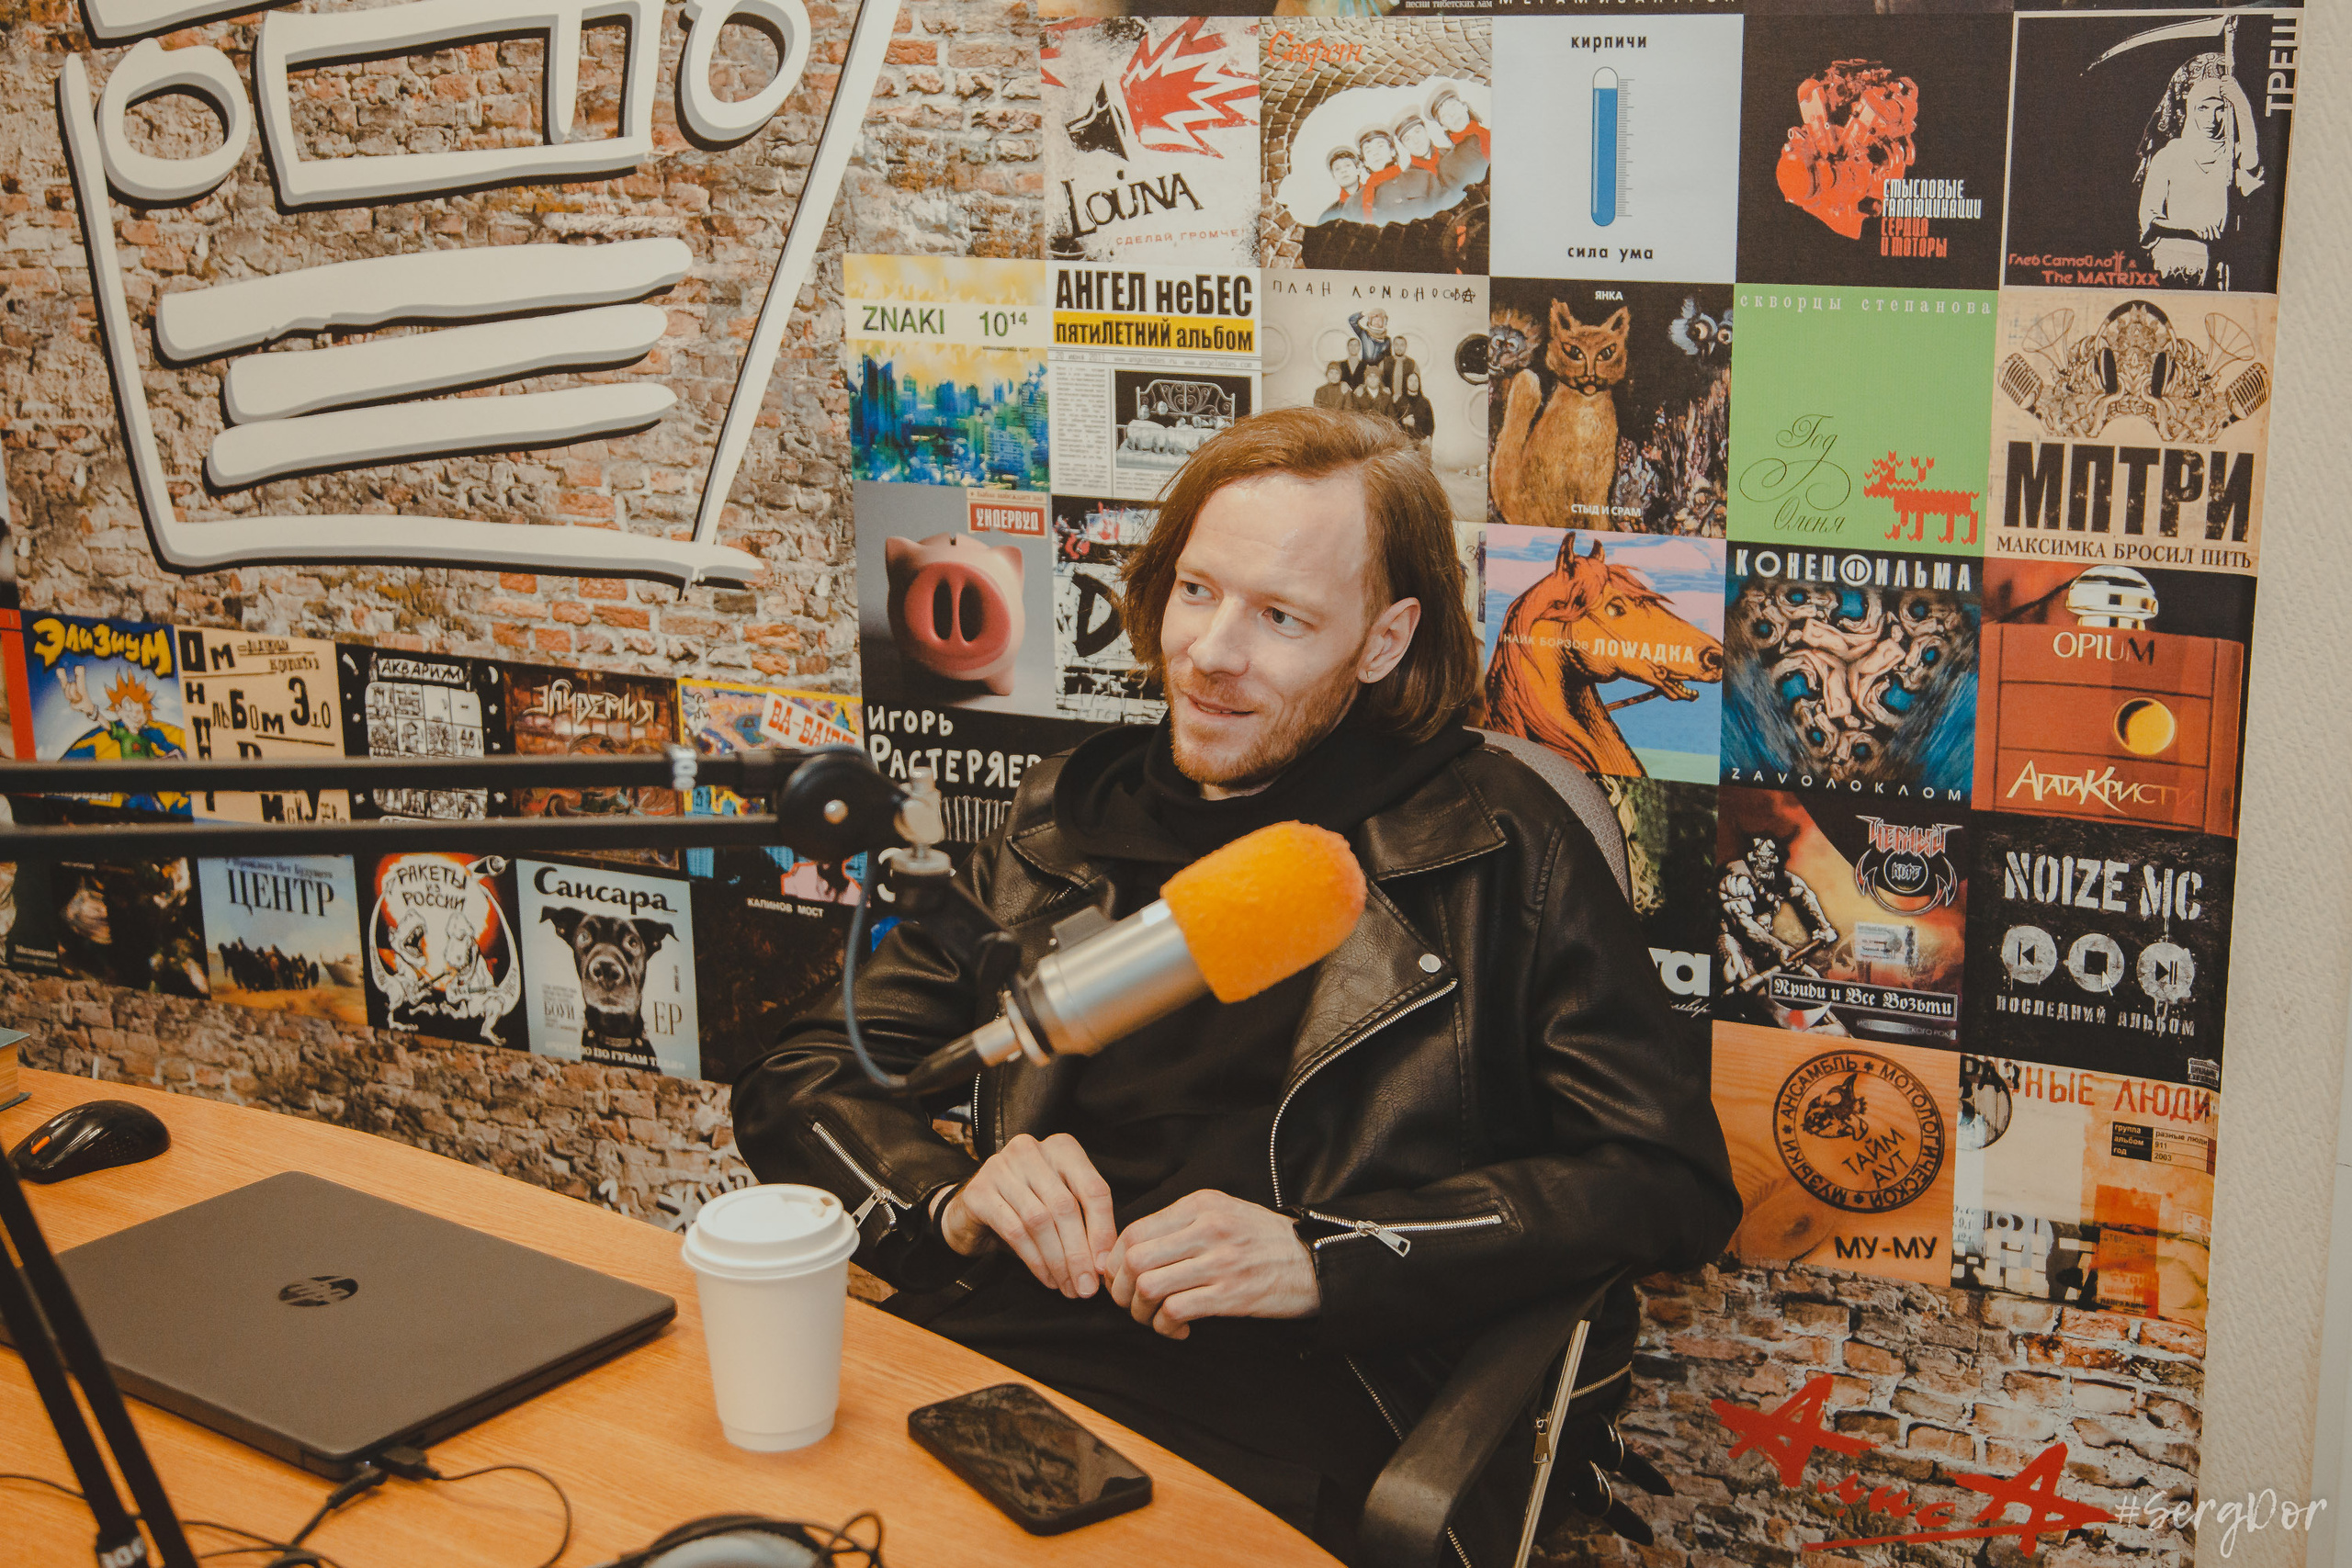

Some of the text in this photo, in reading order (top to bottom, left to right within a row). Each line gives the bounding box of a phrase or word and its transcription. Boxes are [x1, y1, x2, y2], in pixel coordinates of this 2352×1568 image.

[1268, 30, 1363, 73] Секрет
[1570, 36, 1647, 53] кирпичи
[1116, 232, 1172, 245] СДЕЛАЙ
[1567, 247, 1654, 264] сила ума
[1272, 279, 1331, 297] ПЛАН
[2041, 270, 2074, 285] The
[1055, 268, 1253, 317] АНГЕЛ неБЕС
[1594, 290, 1624, 302] ЯНКА
[1739, 293, 1991, 315] скворцы степанова
[862, 305, 945, 334] ZNAKI
[1176, 325, 1254, 352] альбом
[2004, 441, 2255, 543] МПТРИ
[1570, 503, 1643, 518] СТЫД И СРАМ
[1996, 535, 2252, 569] МАКСИМКА БРОСИЛ ПИТЬ
[2052, 630, 2155, 666] OPIUM
[866, 705, 954, 737] ИГОРЬ
[395, 864, 468, 890] РАКЕТЫ
[2004, 851, 2202, 921] NOIZE MC
[227, 868, 335, 917] ЦЕНТР
[401, 891, 467, 912] РОССИИ
[534, 866, 679, 916] Сансара
[1996, 994, 2195, 1038] ПОСЛЕДНИЙ АЛЬБОМ
[2112, 1078, 2211, 1124] ЛЮДИ
[2113, 1135, 2168, 1150] альбом 911
[2114, 1124, 2142, 1135] группа
[1842, 1127, 1905, 1176] ТАЙМ
[2113, 1146, 2173, 1162] год 2003
[1871, 1150, 1910, 1189] АУТ
[1834, 1235, 1938, 1260] МУ-МУ
